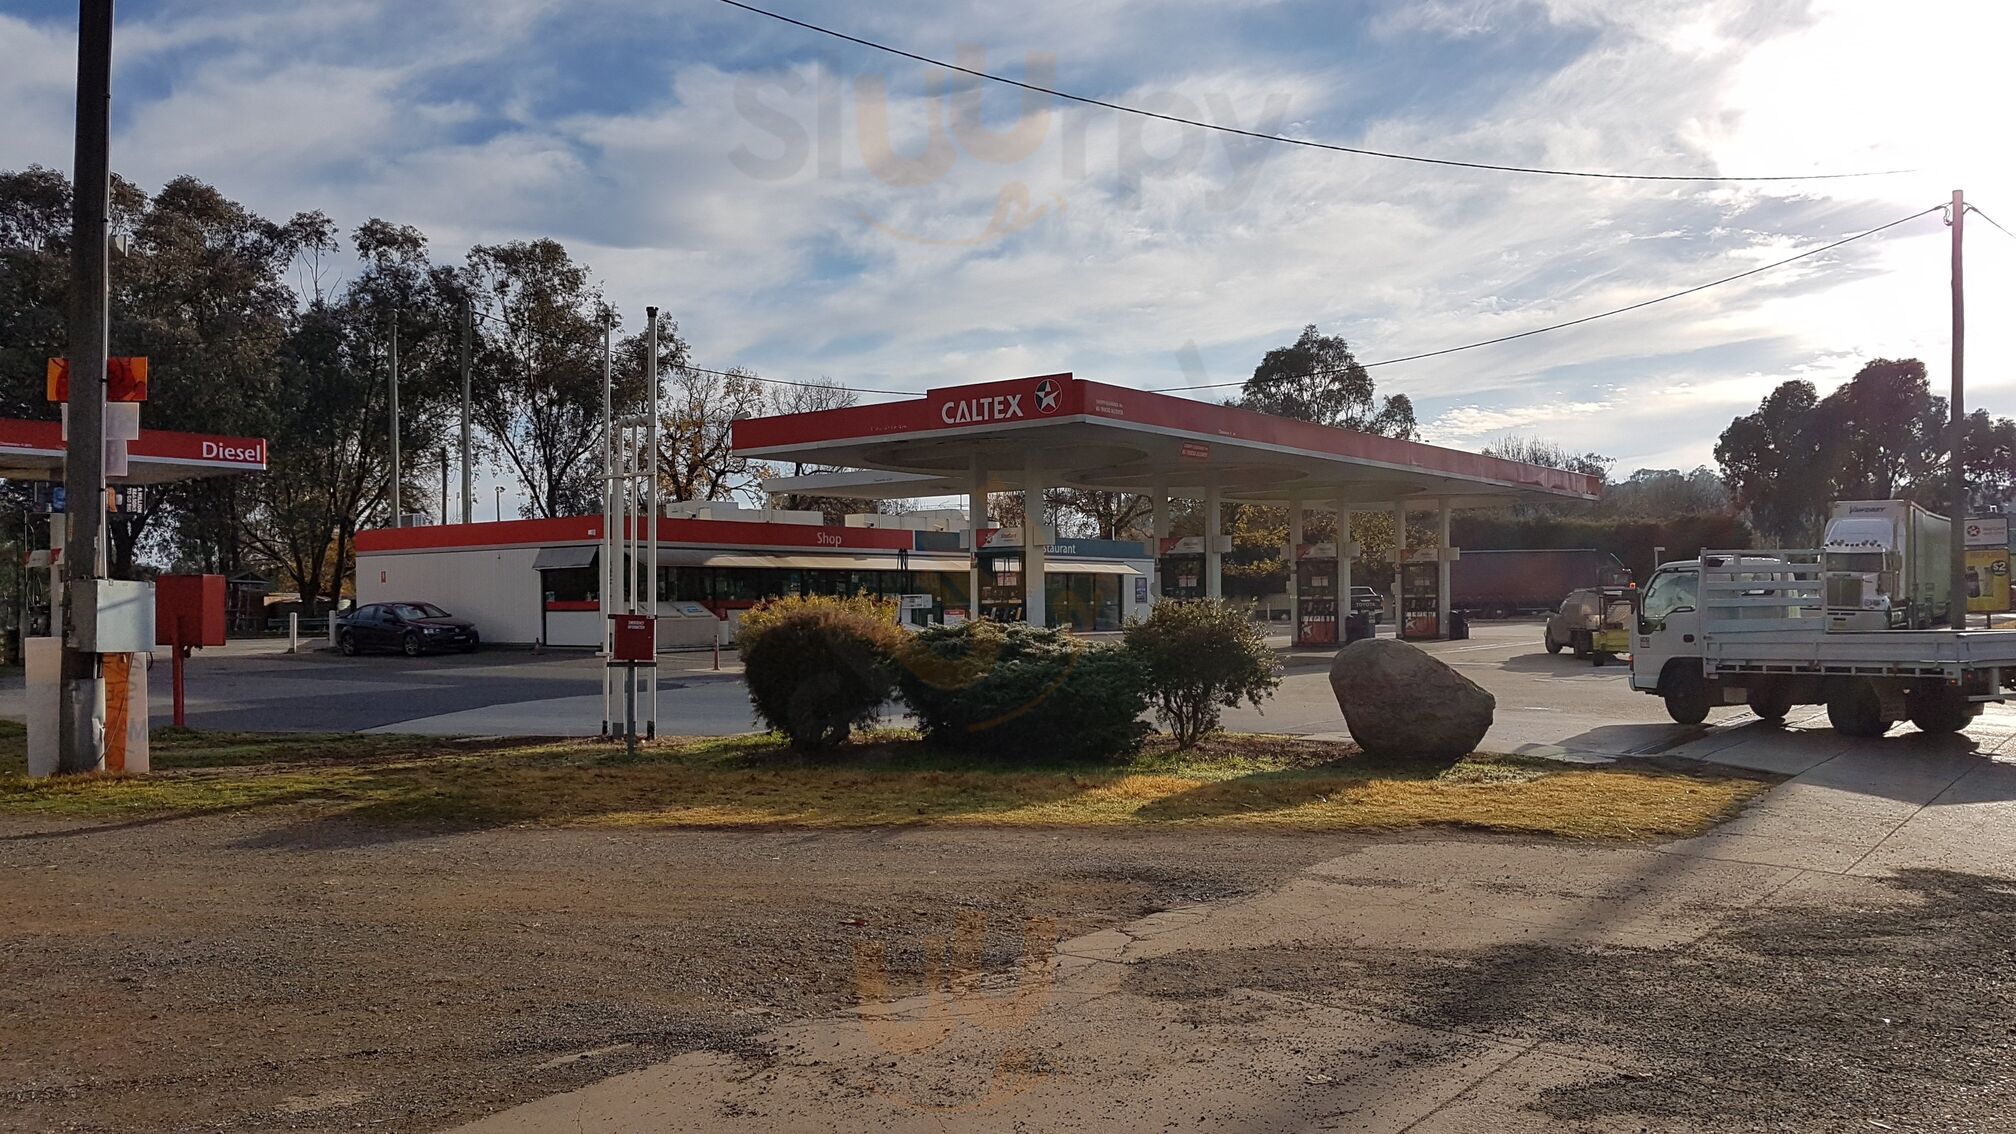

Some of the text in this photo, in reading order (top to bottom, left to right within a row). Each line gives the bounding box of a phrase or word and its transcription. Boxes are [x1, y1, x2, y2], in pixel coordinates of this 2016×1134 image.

[941, 394, 1024, 425] CALTEX
[202, 441, 261, 462] Diesel
[817, 532, 842, 548] Shop
[1043, 544, 1076, 554] staurant
[1992, 562, 2006, 571] $2
